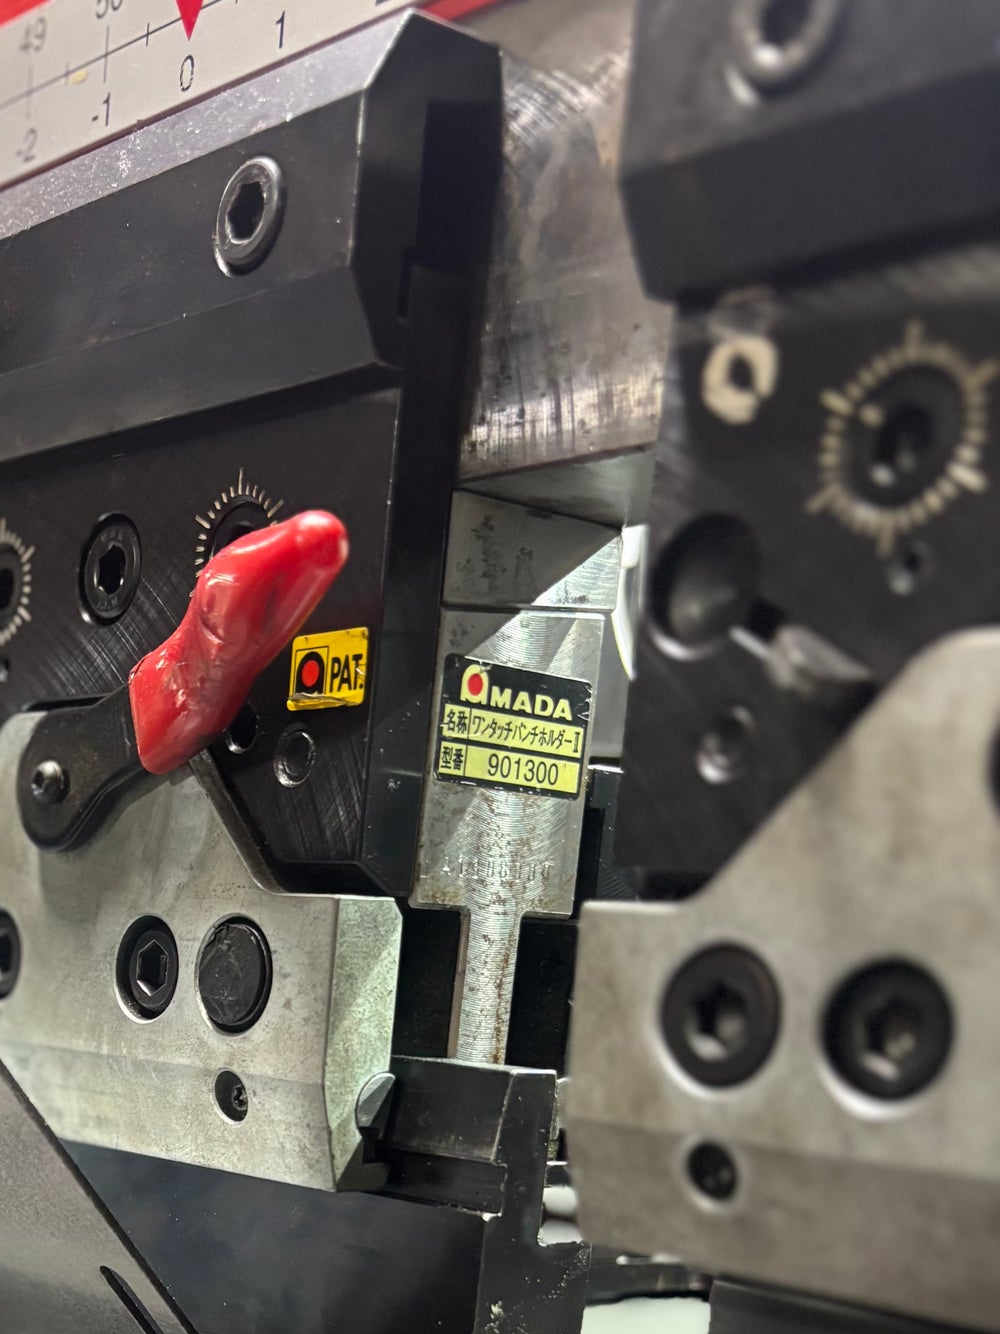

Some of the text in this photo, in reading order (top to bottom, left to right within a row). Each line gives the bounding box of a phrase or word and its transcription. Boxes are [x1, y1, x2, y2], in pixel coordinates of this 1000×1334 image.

[91, 92, 111, 127] -1
[179, 54, 195, 92] 0
[275, 10, 286, 49] 1
[329, 653, 364, 693] PAT.
[440, 746, 560, 786] 型番 901300
